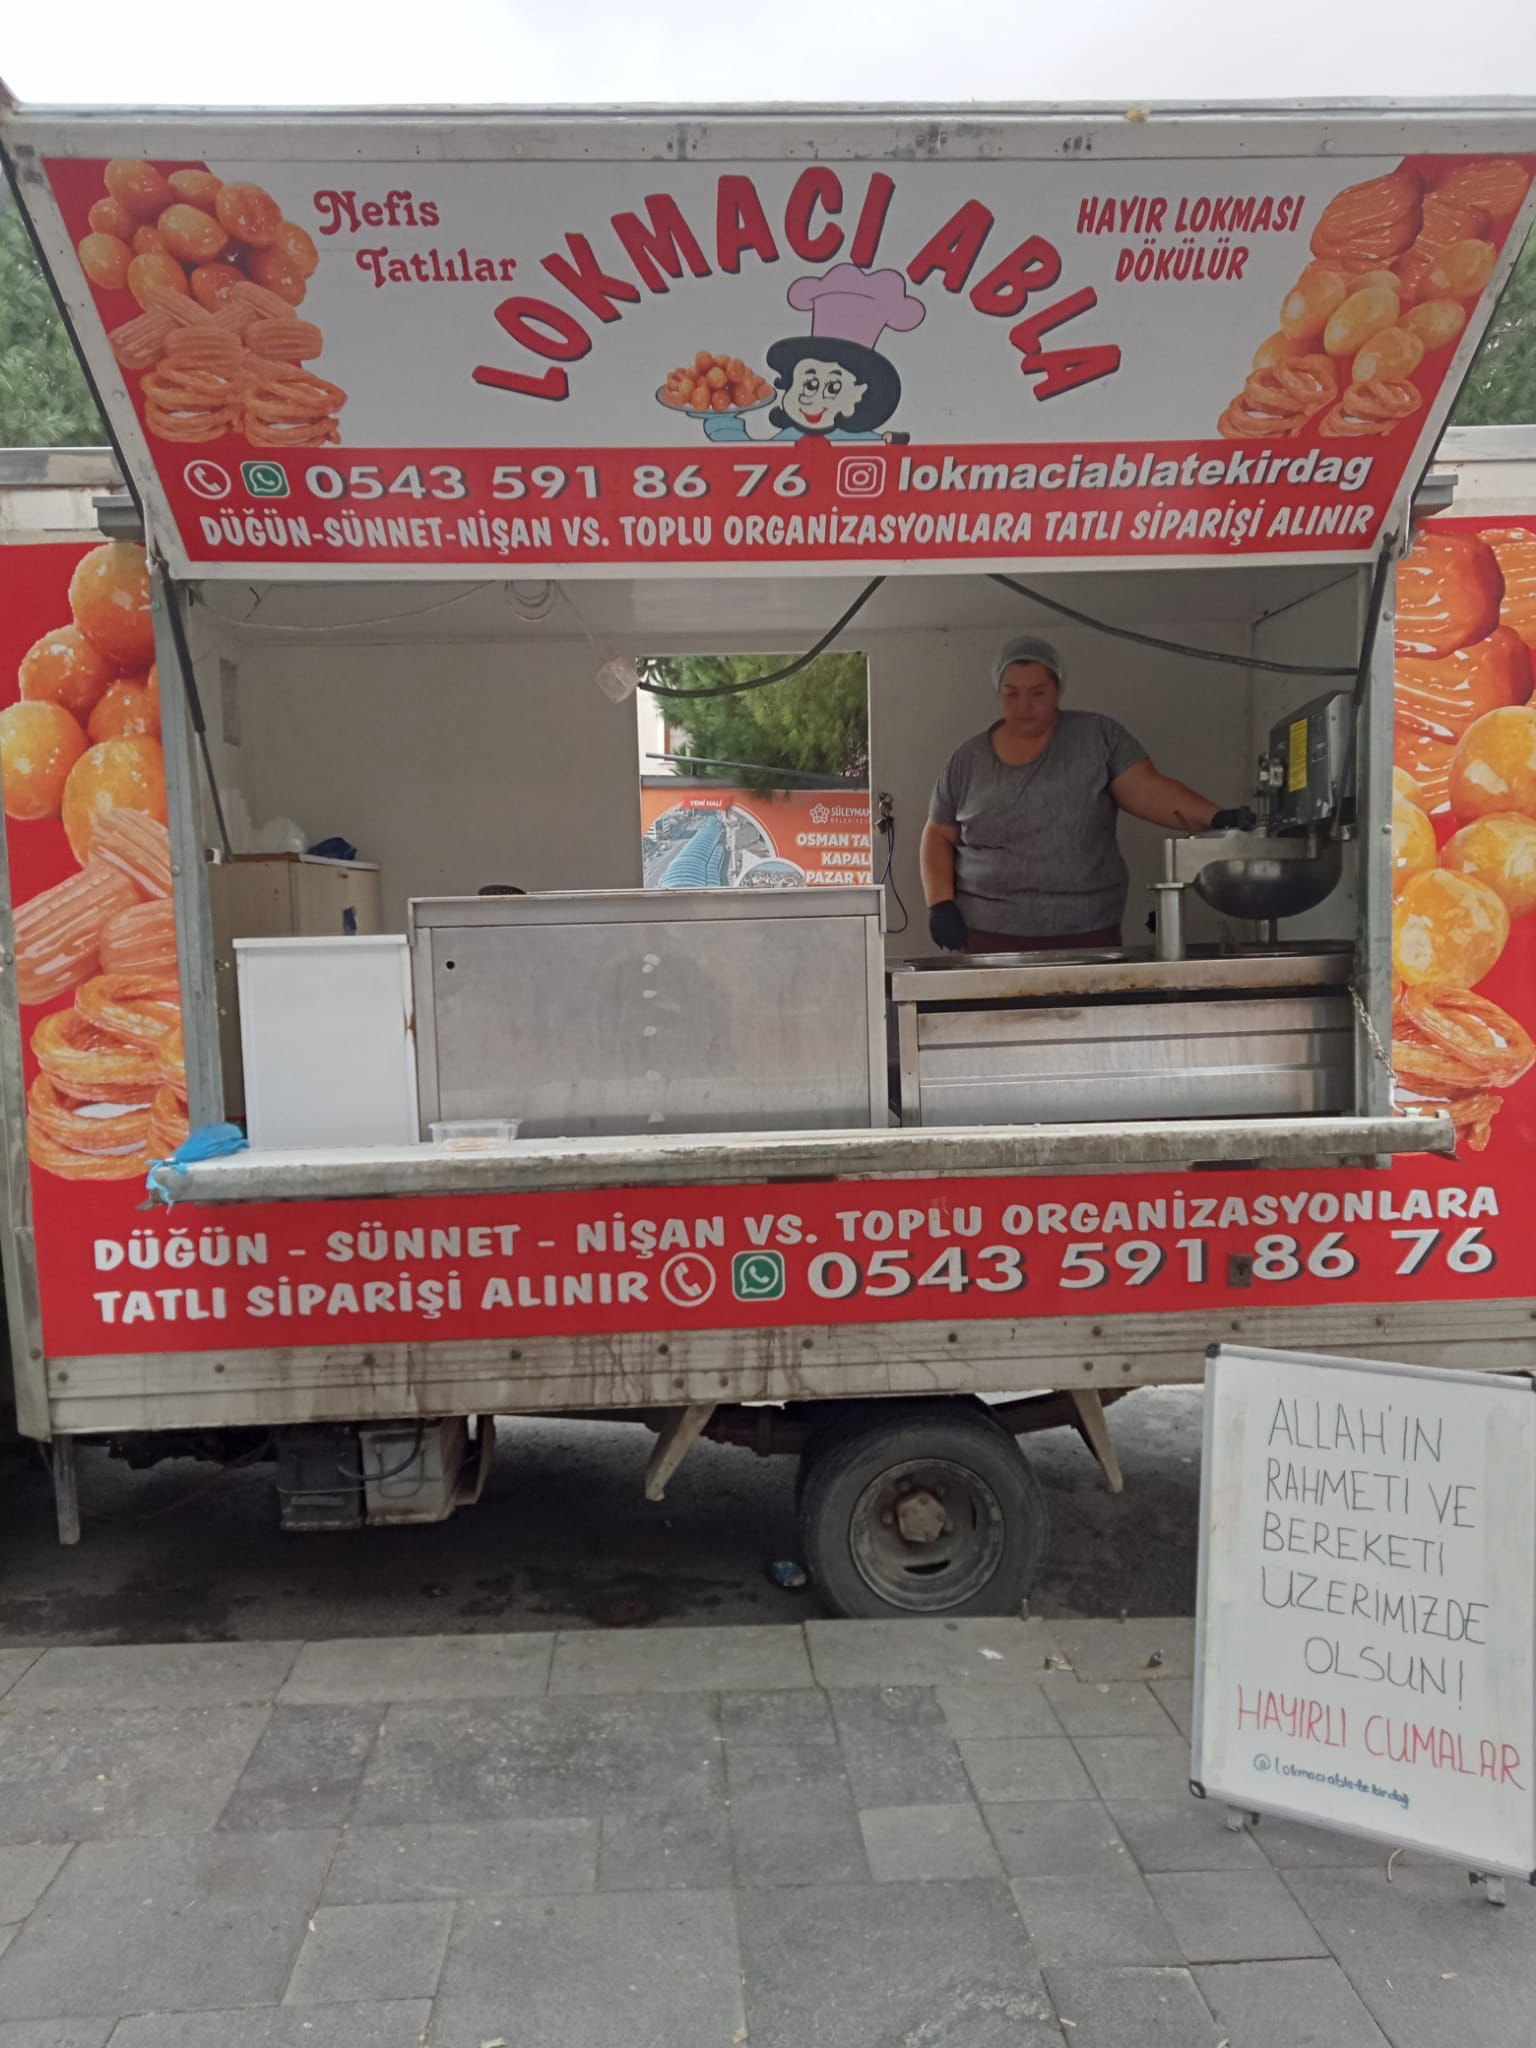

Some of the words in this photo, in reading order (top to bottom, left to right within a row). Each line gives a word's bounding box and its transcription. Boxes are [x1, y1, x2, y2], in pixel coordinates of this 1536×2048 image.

[313, 190, 440, 235] Nefis
[1076, 195, 1168, 235] HAYIR
[1174, 195, 1306, 233] LOKMASI
[355, 246, 517, 289] Tatlılar
[1115, 237, 1249, 282] DÖKÜLÜR
[472, 166, 896, 401] LOKMACI
[906, 199, 1121, 401] ABLA
[305, 465, 467, 499] 0543
[493, 464, 600, 499] 591
[632, 464, 708, 498] 86
[733, 464, 808, 498] 76
[898, 449, 1374, 491] lokmaciablatekirdag
[200, 507, 552, 554] DÜĞÜN-SÜNNET-NİŞAN
[562, 517, 609, 546] VS.
[619, 516, 712, 546] TOPLU
[723, 506, 1031, 546] ORGANİZASYONLARA
[1045, 509, 1124, 541] TATLI
[1130, 500, 1266, 546] SİPARİŞİ
[1269, 504, 1374, 538] ALINIR
[796, 832, 849, 848] OSMAN
[851, 832, 870, 848] TA
[806, 870, 854, 885] PAZAR
[94, 1226, 268, 1271] DÜĞÜN
[325, 1221, 520, 1262] SÜNNET
[537, 1240, 555, 1248] -
[577, 1212, 724, 1259] NİŞAN
[744, 1214, 818, 1246] VS.
[836, 1206, 982, 1242] TOPLU
[1002, 1186, 1500, 1236] ORGANİZASYONLARA
[807, 1244, 1024, 1299] 0543
[1059, 1239, 1206, 1289] 591
[1252, 1232, 1356, 1281] 86
[1391, 1227, 1494, 1275] 76
[93, 1287, 226, 1323] TATLI
[246, 1270, 462, 1319] SİPARİŞİ
[481, 1271, 649, 1310] ALINIR
[1268, 1398, 1442, 1462] ALLAH'IN
[1428, 1483, 1476, 1528] VE
[1304, 1637, 1463, 1711] OLSUN!
[1237, 1684, 1346, 1748] HAYIRLI
[1364, 1715, 1525, 1791] CUMALAR
